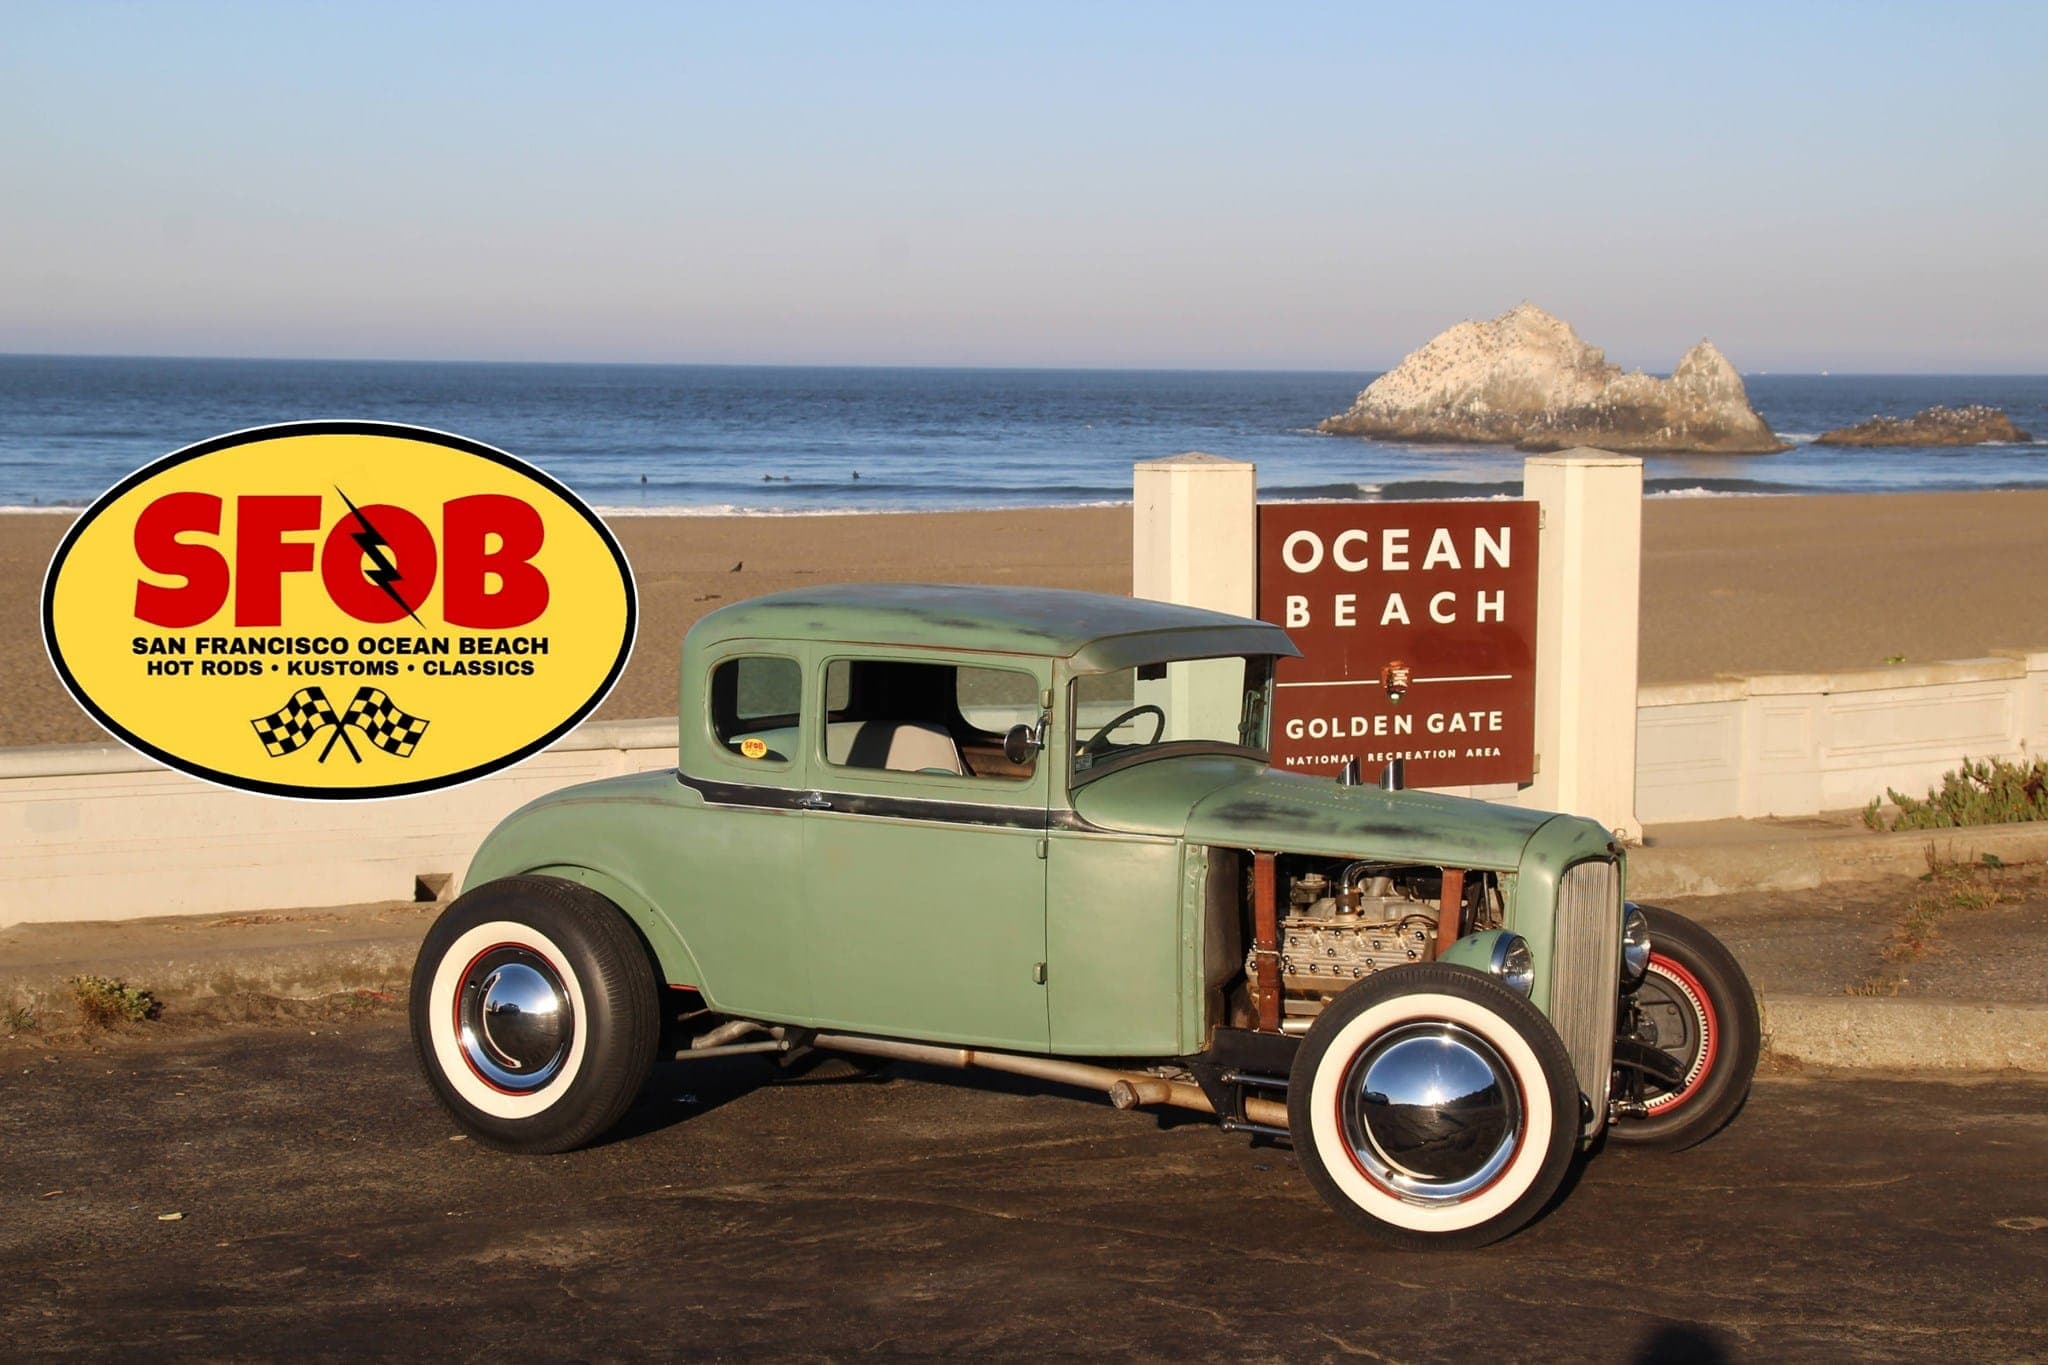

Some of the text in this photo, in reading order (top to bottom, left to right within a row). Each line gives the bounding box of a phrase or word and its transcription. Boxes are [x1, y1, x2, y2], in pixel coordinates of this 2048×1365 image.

[1282, 526, 1511, 574] OCEAN
[1286, 590, 1505, 628] BEACH
[1285, 710, 1503, 740] GOLDEN GATE
[1367, 749, 1456, 762] RECREATION
[1465, 747, 1501, 757] AREA
